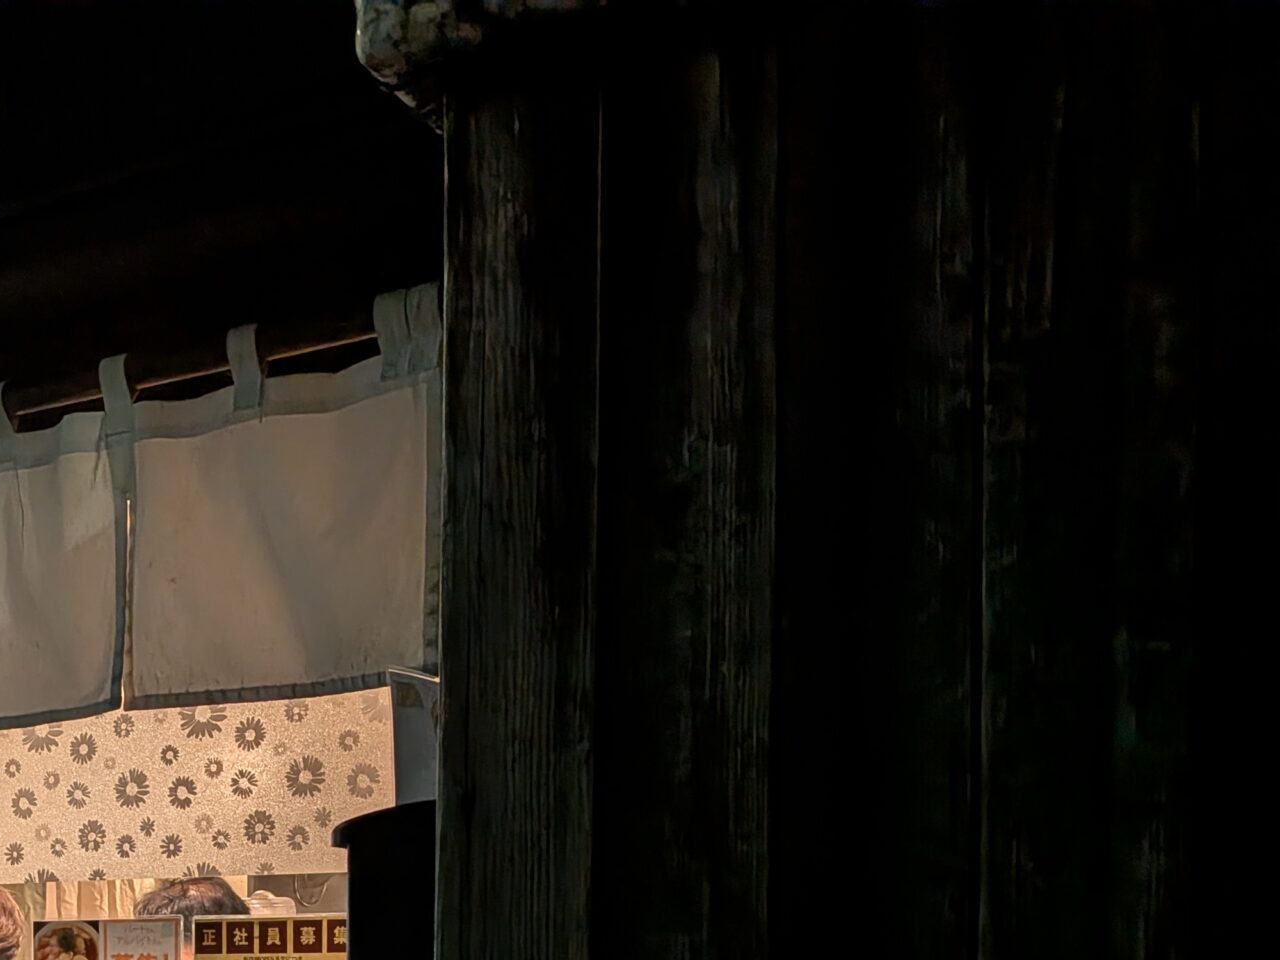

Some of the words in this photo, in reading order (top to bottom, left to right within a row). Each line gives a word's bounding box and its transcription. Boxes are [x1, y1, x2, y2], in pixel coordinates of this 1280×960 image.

[202, 926, 347, 946] 正社員募集
